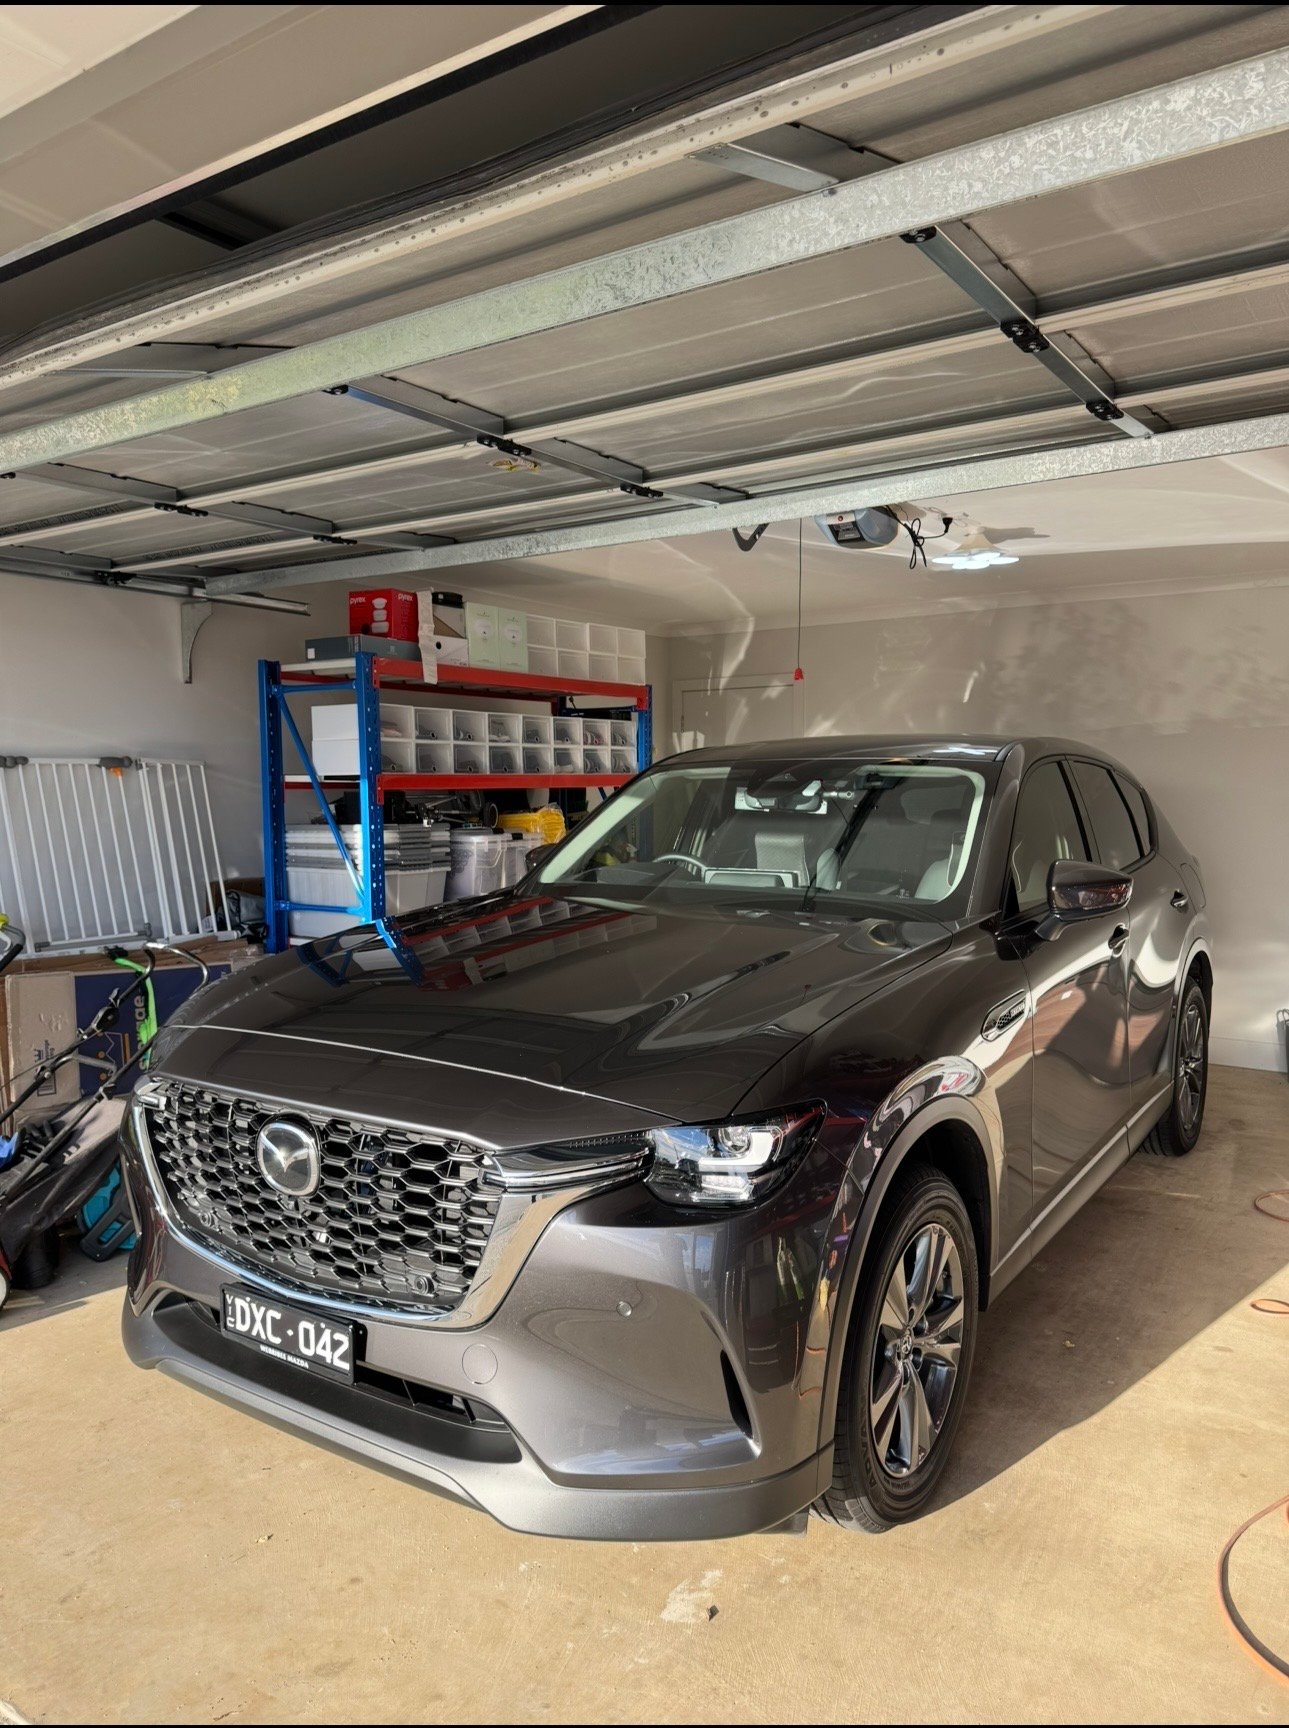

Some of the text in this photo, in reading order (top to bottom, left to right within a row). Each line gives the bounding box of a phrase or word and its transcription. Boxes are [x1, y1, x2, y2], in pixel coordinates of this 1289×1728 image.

[349, 596, 366, 605] pyrex
[226, 1293, 235, 1327] VIC
[287, 1354, 309, 1369] MAZDA
